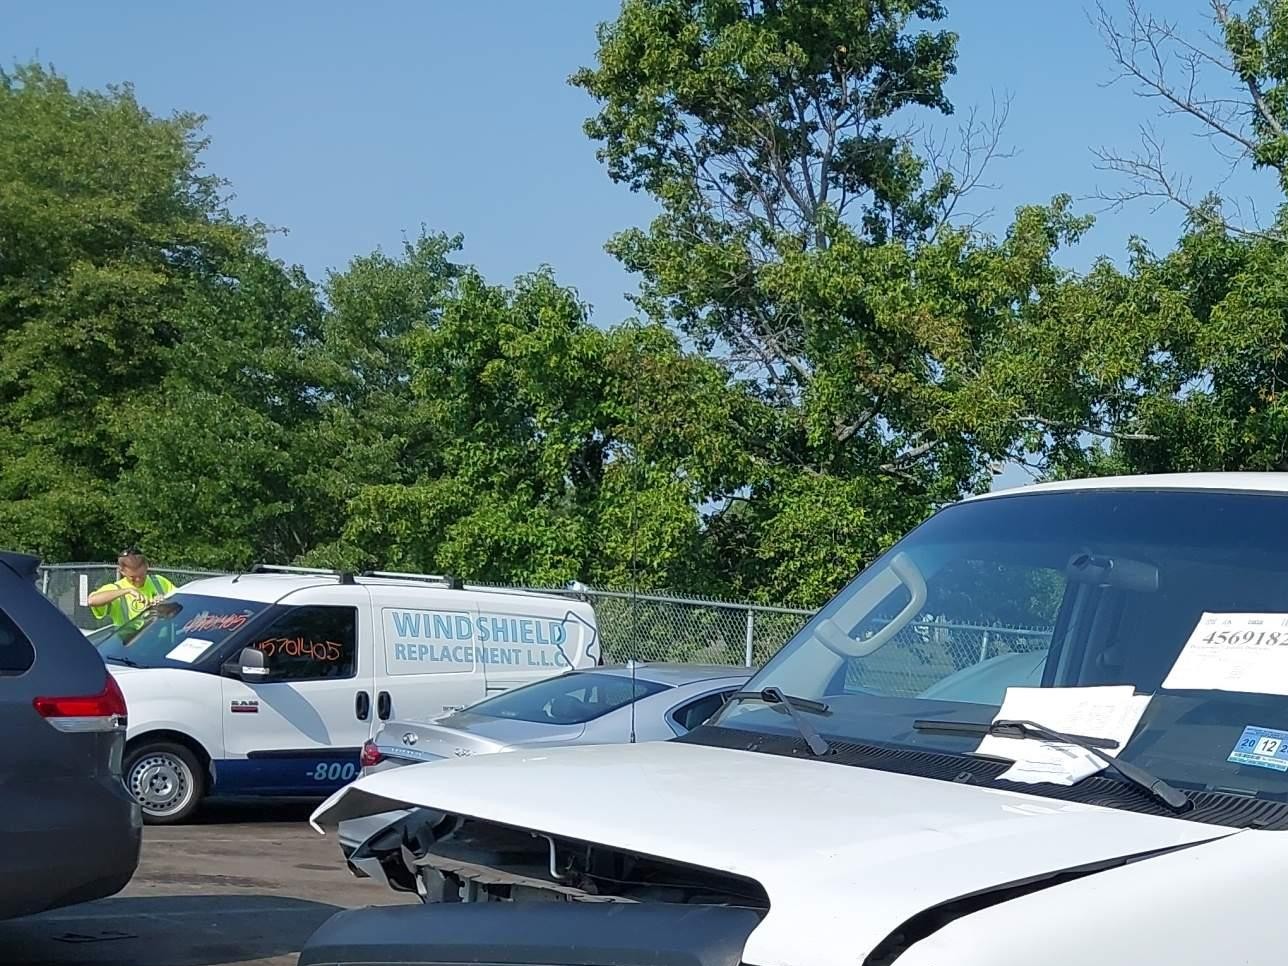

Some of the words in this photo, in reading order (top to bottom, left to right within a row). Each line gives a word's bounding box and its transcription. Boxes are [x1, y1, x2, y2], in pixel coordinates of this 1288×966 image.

[392, 611, 567, 645] WINDSHIELD
[395, 643, 522, 665] REPLACEMENT
[1241, 738, 1256, 747] 20
[1262, 740, 1278, 752] 12
